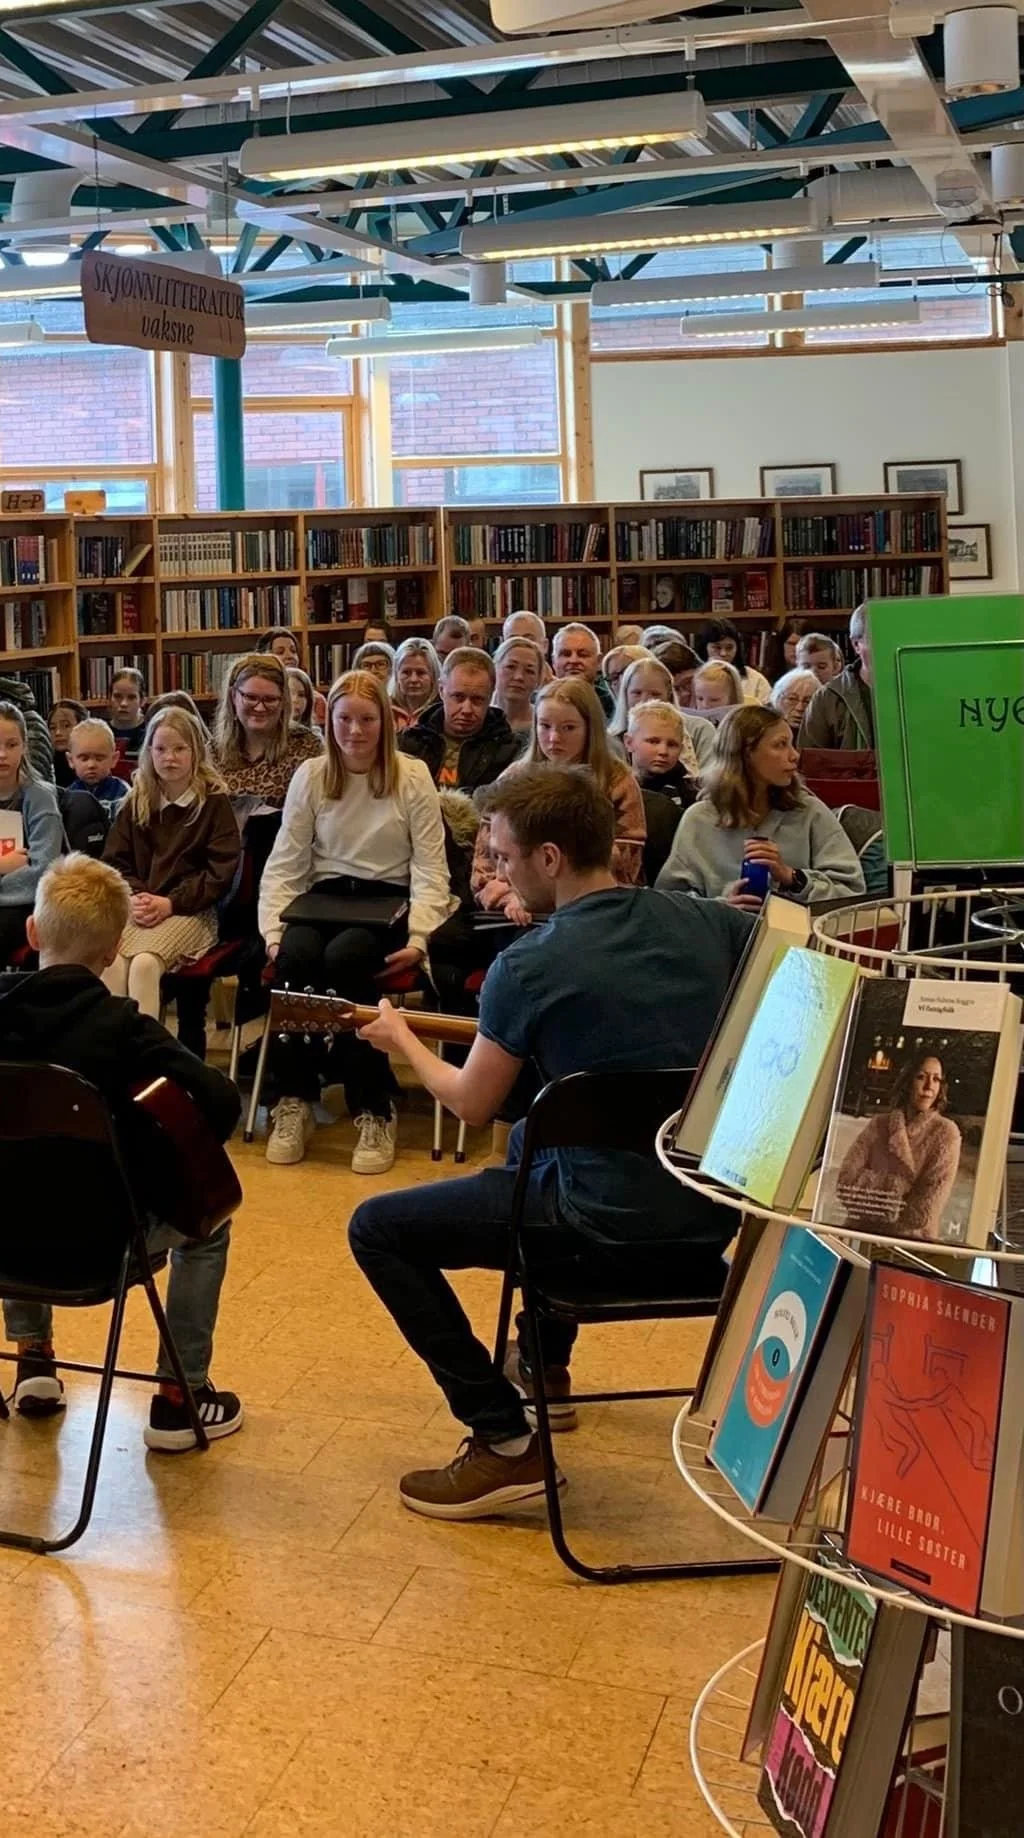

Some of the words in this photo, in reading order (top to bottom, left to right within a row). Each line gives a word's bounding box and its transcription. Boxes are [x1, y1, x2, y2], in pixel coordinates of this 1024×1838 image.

[141, 310, 194, 345] vaksne
[5, 493, 42, 510] H-P
[881, 1283, 929, 1311] SOPHIA
[860, 1485, 902, 1515] KJÆRE
[877, 1518, 913, 1545] LILLE
[919, 1535, 966, 1569] SØSTER
